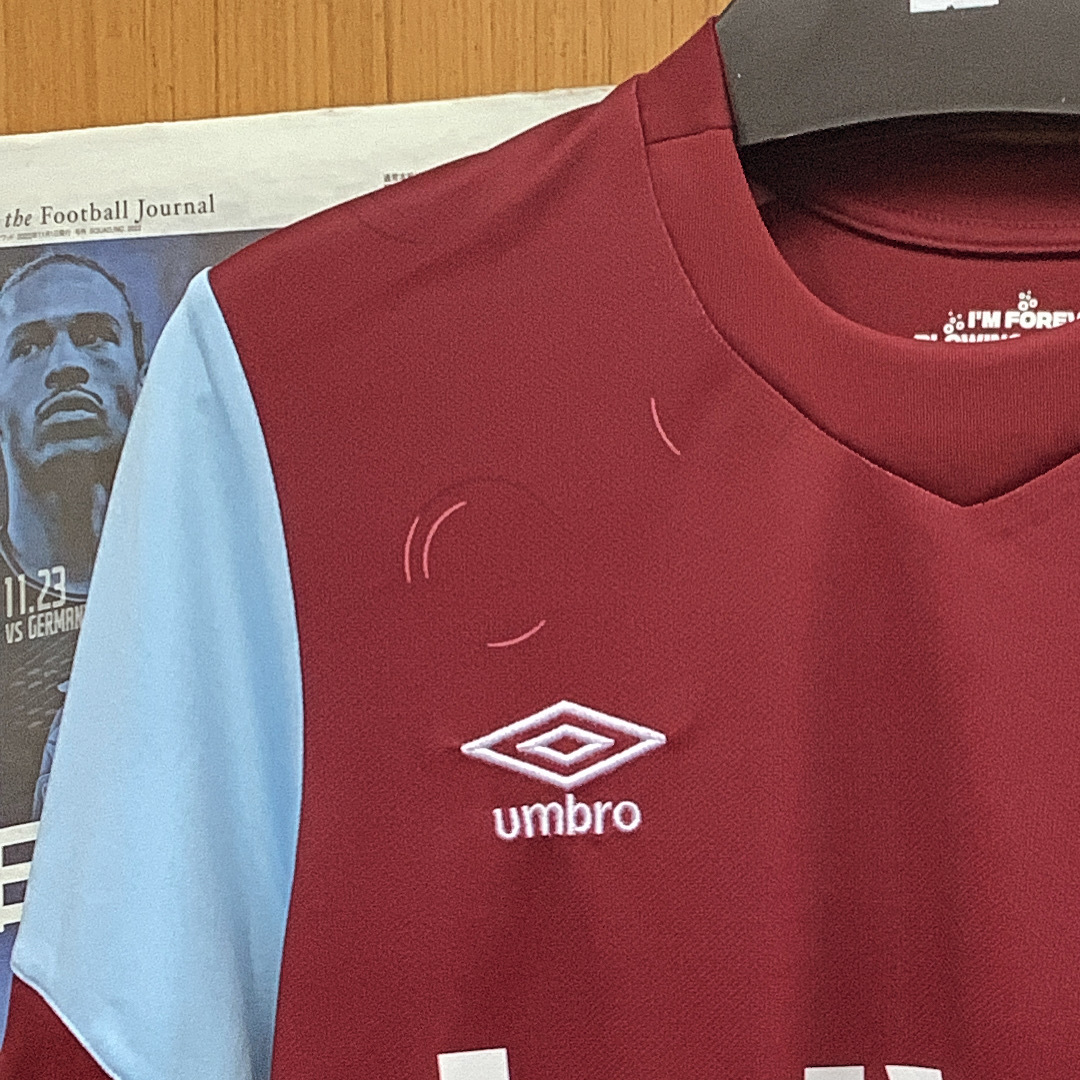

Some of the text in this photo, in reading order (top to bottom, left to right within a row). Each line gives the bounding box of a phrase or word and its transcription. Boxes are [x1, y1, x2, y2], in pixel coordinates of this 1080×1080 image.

[5, 193, 215, 228] the Football Journal
[967, 310, 1001, 329] I'M
[4, 565, 66, 618] 11.23
[5, 621, 24, 644] VS
[492, 793, 643, 841] umbro
